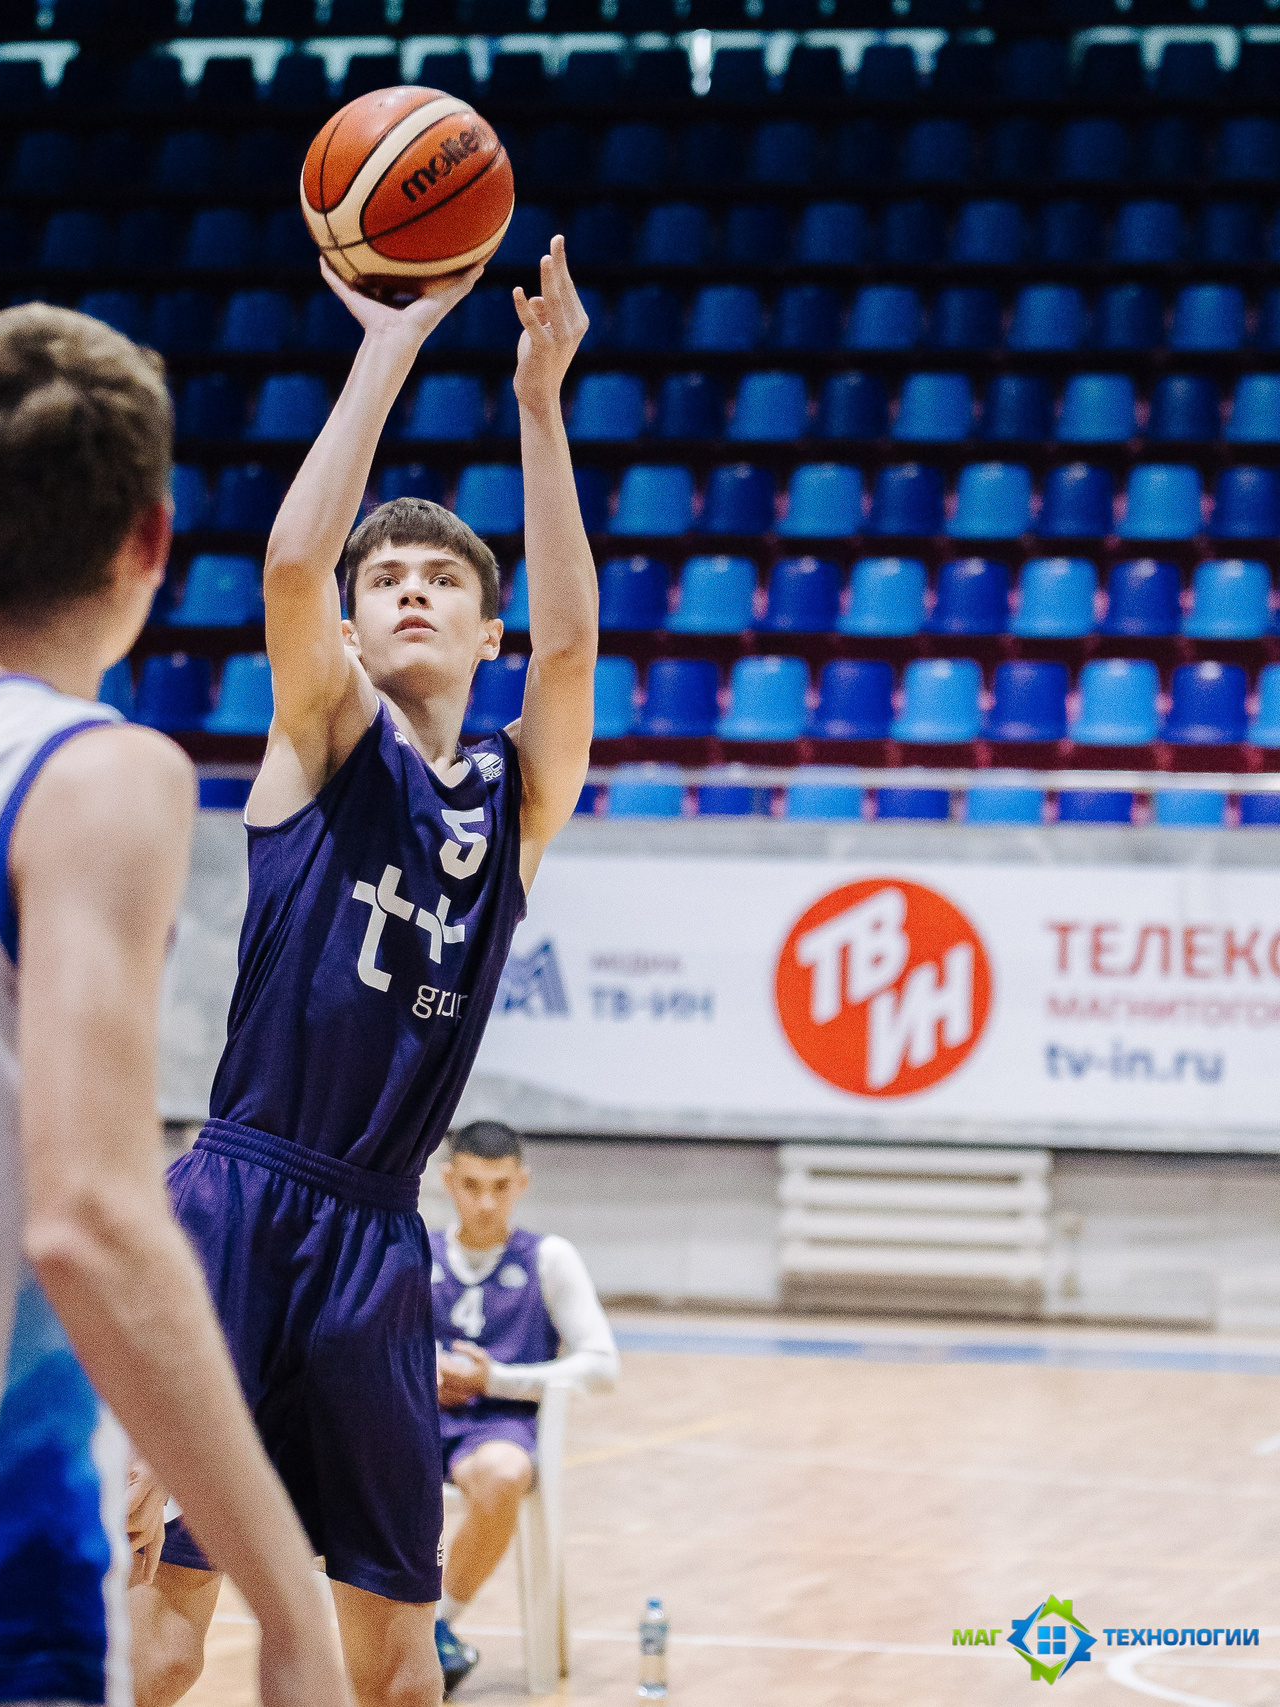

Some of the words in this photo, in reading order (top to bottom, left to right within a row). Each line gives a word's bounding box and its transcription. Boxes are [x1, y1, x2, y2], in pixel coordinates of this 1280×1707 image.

[401, 124, 480, 202] molte
[439, 807, 488, 880] 5
[795, 886, 911, 1026] ТВ
[1044, 919, 1280, 980] ТЕЛЕК
[865, 941, 975, 1091] ИН
[1045, 996, 1280, 1025] МАГНИТОГО
[1045, 1037, 1224, 1084] tv-in.ru
[451, 1286, 487, 1338] 4
